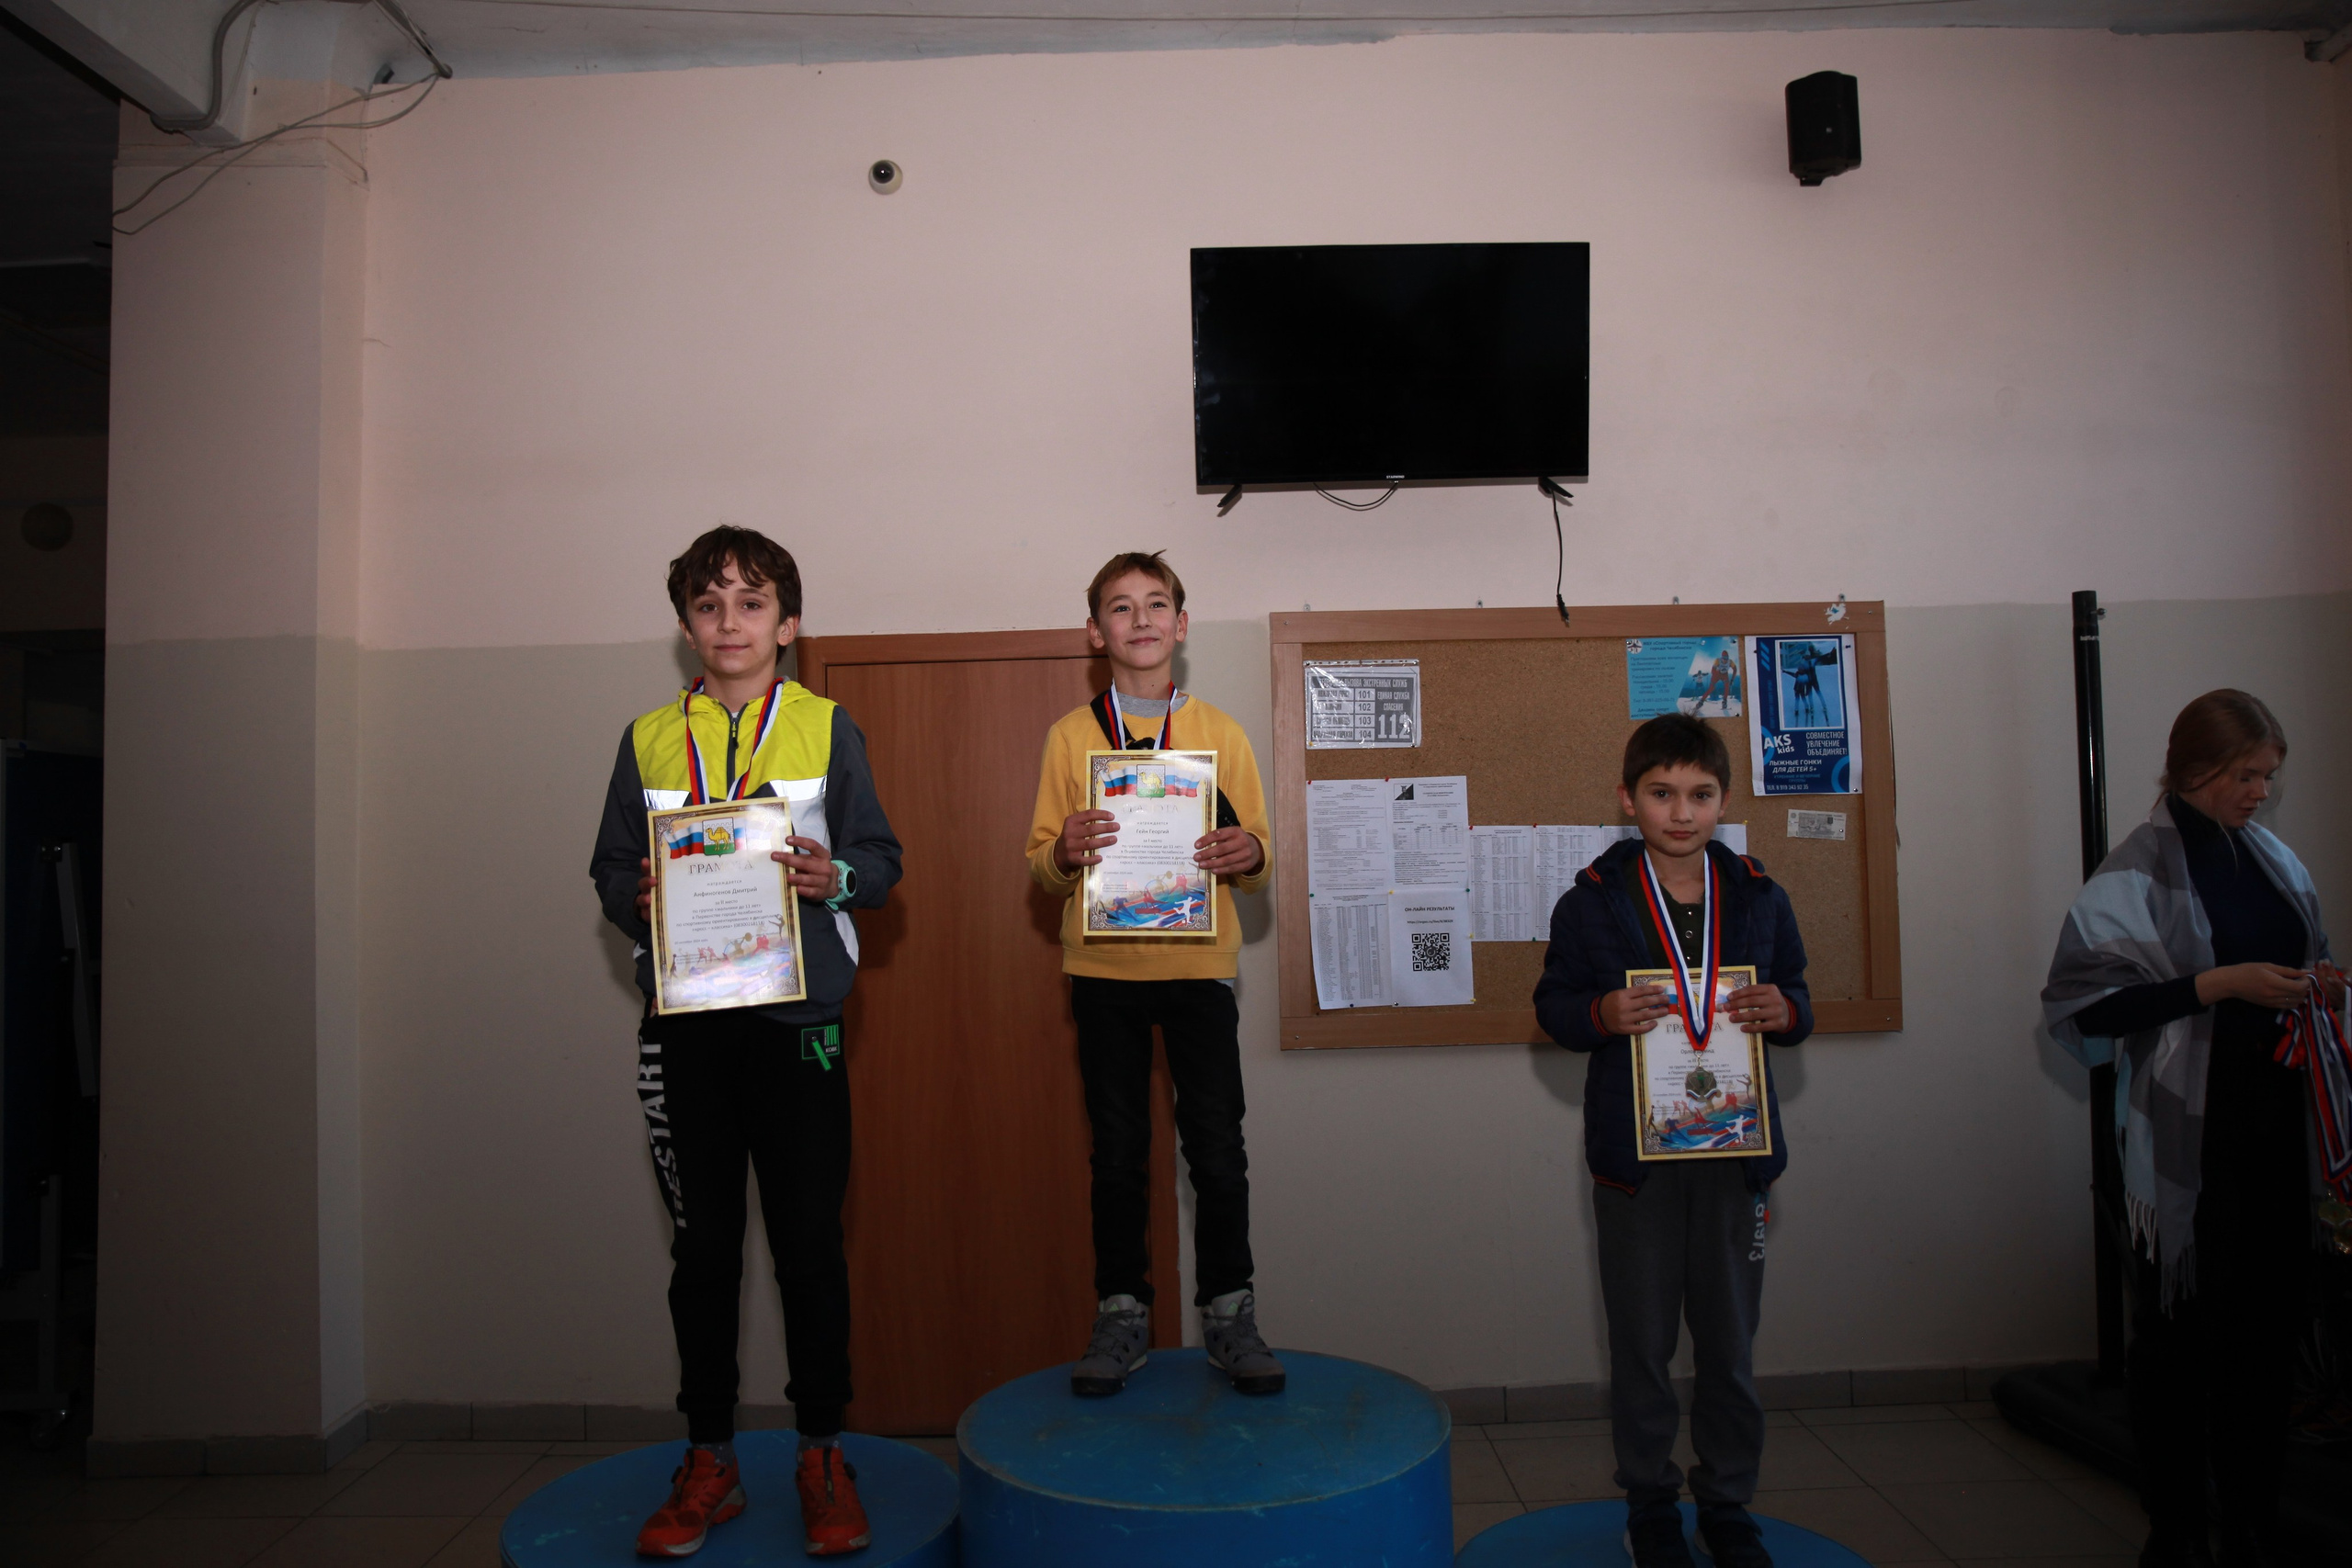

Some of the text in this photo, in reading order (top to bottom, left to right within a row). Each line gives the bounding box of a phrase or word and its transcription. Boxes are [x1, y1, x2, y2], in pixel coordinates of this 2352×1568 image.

[1359, 690, 1371, 699] 101
[1359, 703, 1371, 712] 102
[1359, 716, 1372, 725] 103
[1378, 714, 1410, 739] 112
[1359, 730, 1372, 739] 104
[1805, 731, 1845, 739] СОВМЕСТНОЕ
[1764, 734, 1792, 750] AKS
[1806, 739, 1840, 749] УВЛЕЧЕНИЕ
[1777, 745, 1795, 754] kids
[732, 886, 758, 896] Дмитрий
[1666, 1021, 1723, 1033] ГРАА
